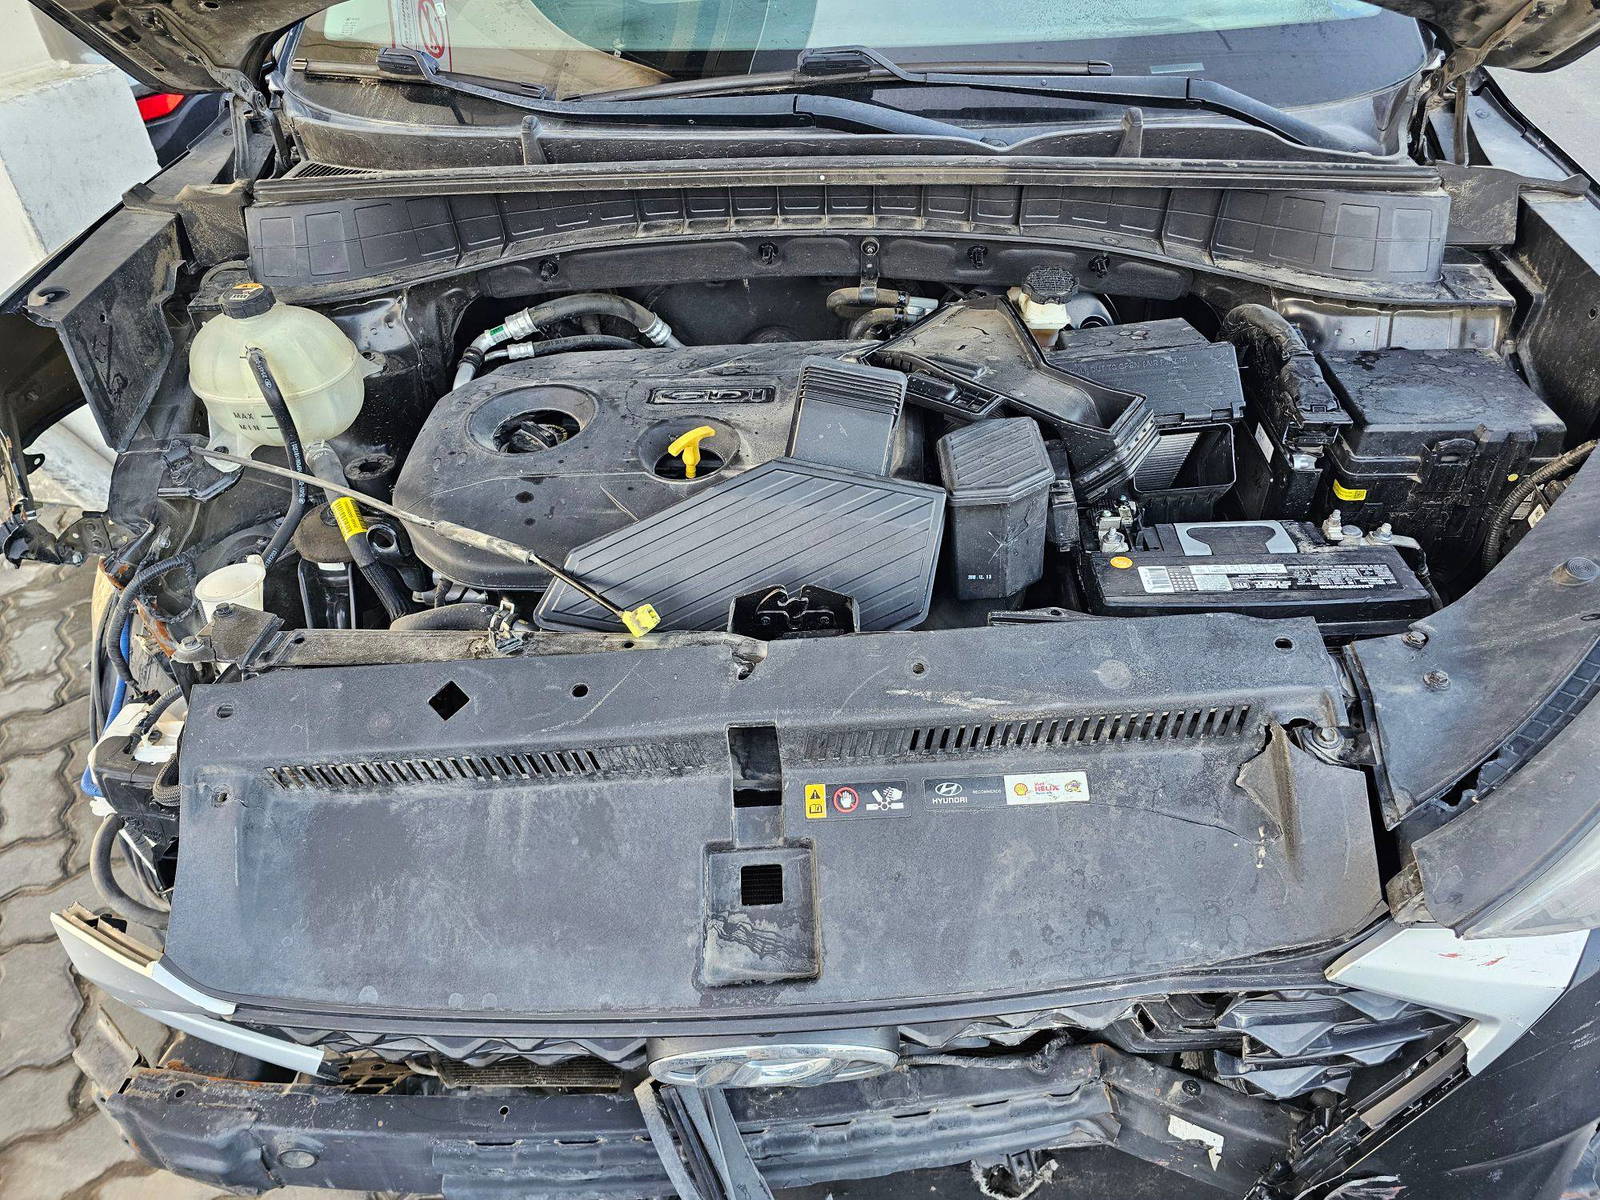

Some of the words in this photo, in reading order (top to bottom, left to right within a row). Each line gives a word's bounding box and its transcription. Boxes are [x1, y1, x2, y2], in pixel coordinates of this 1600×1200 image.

[1119, 360, 1140, 371] OPEN
[655, 388, 767, 404] GDI
[233, 411, 255, 420] MAX
[239, 423, 260, 431] MIN
[932, 796, 968, 805] HYUNDAI
